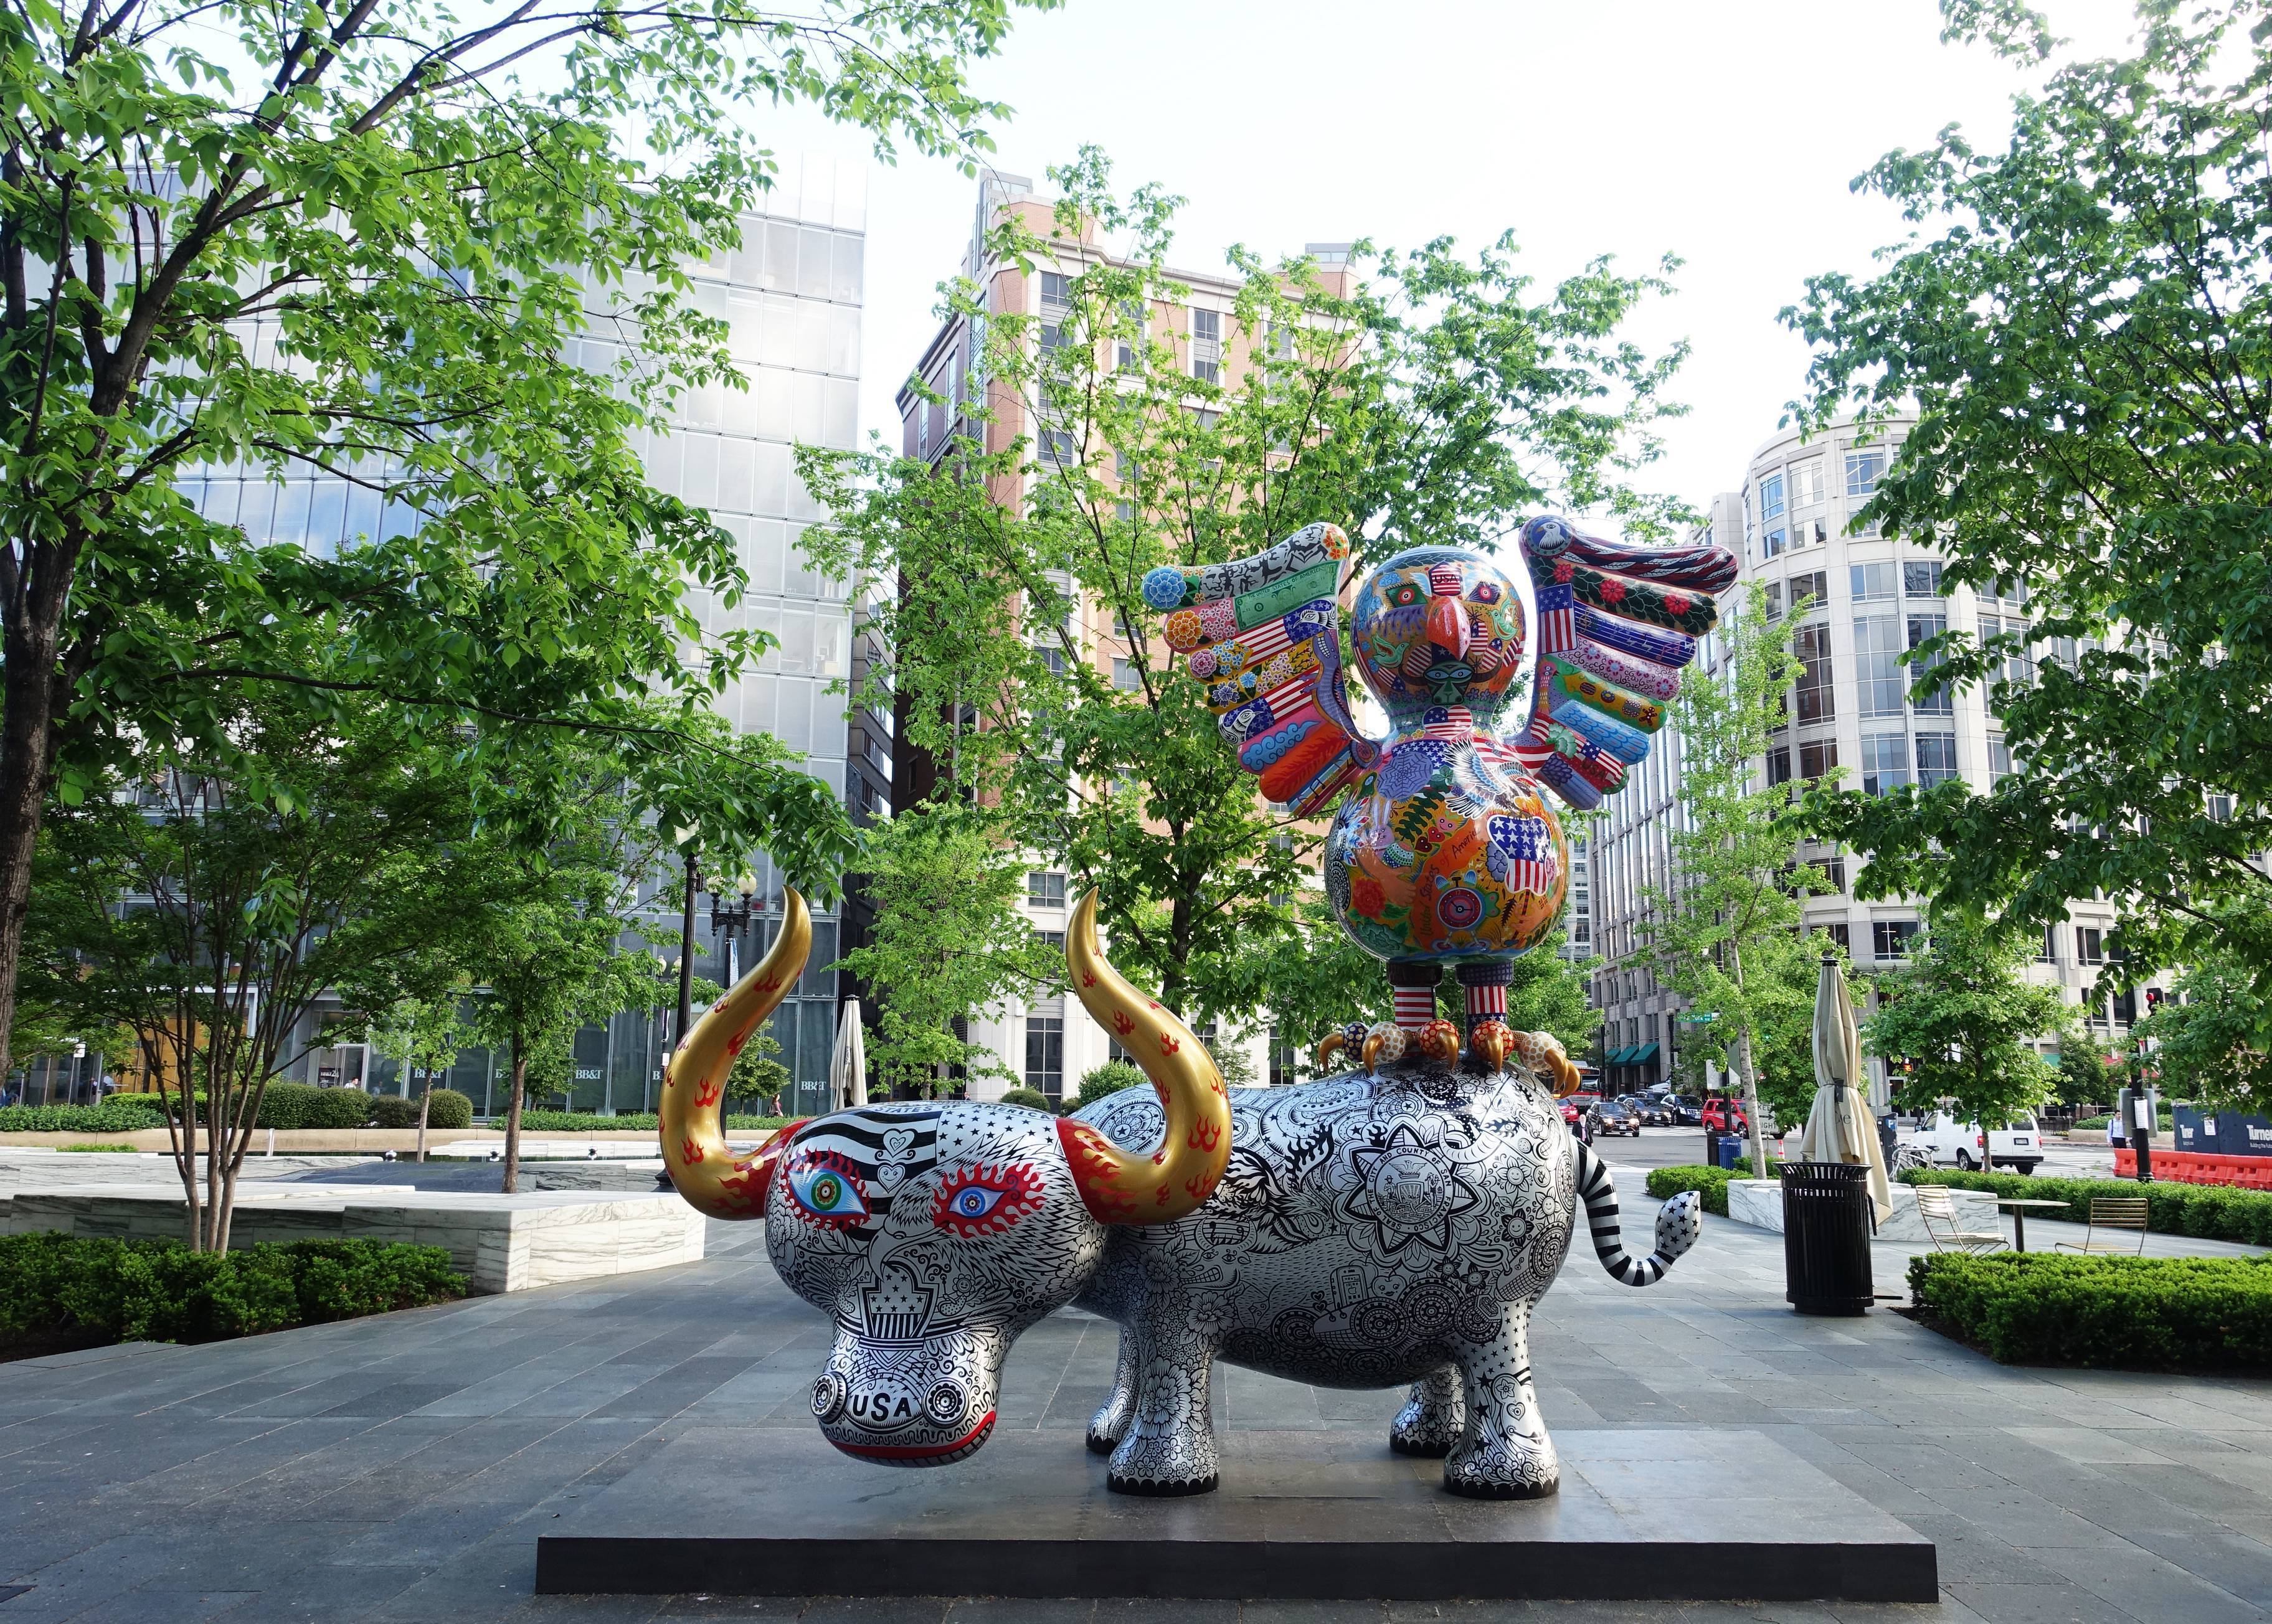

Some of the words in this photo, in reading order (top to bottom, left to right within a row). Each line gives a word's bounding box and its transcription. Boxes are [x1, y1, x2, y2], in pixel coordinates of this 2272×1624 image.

[1434, 574, 1458, 583] USA
[1272, 581, 1290, 591] STATES
[1582, 758, 1606, 782] USA
[1420, 864, 1439, 901] States
[1440, 849, 1449, 868] of
[575, 1070, 603, 1079] BB&T
[801, 1081, 826, 1090] BB&T
[972, 1104, 1051, 1120] AMERICA
[1379, 1153, 1392, 1164] AND
[1396, 1148, 1429, 1157] COUNTY
[1431, 1157, 1441, 1165] OF
[1368, 1166, 1378, 1183] CITY
[1441, 1169, 1452, 1186] SAN
[1373, 1206, 1381, 1215] OF
[1414, 1196, 1451, 1231] FRANCISCO
[1381, 1214, 1402, 1230] SEAL
[853, 1392, 912, 1422] USA
